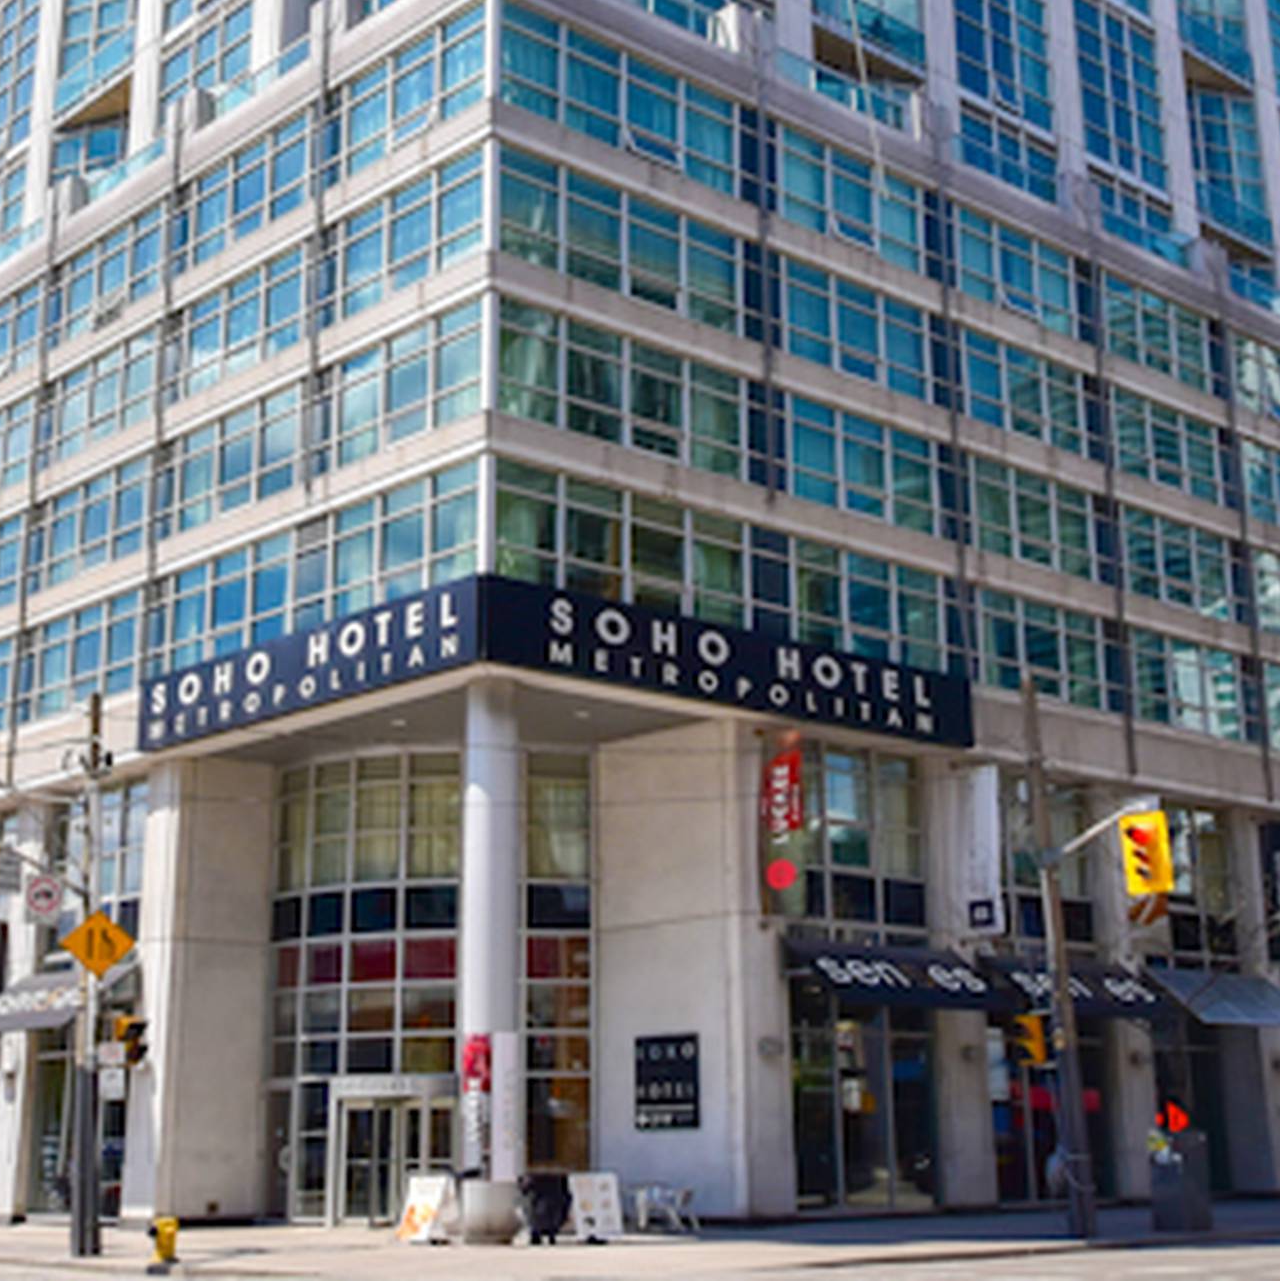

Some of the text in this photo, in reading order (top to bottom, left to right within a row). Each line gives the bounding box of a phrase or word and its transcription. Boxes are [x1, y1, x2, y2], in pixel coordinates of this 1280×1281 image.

[148, 634, 459, 741] METROPOLITAN
[150, 592, 458, 715] SOHO HOTEL
[548, 640, 936, 733] METROPOLITAN
[549, 598, 932, 710] SOHO HOTEL
